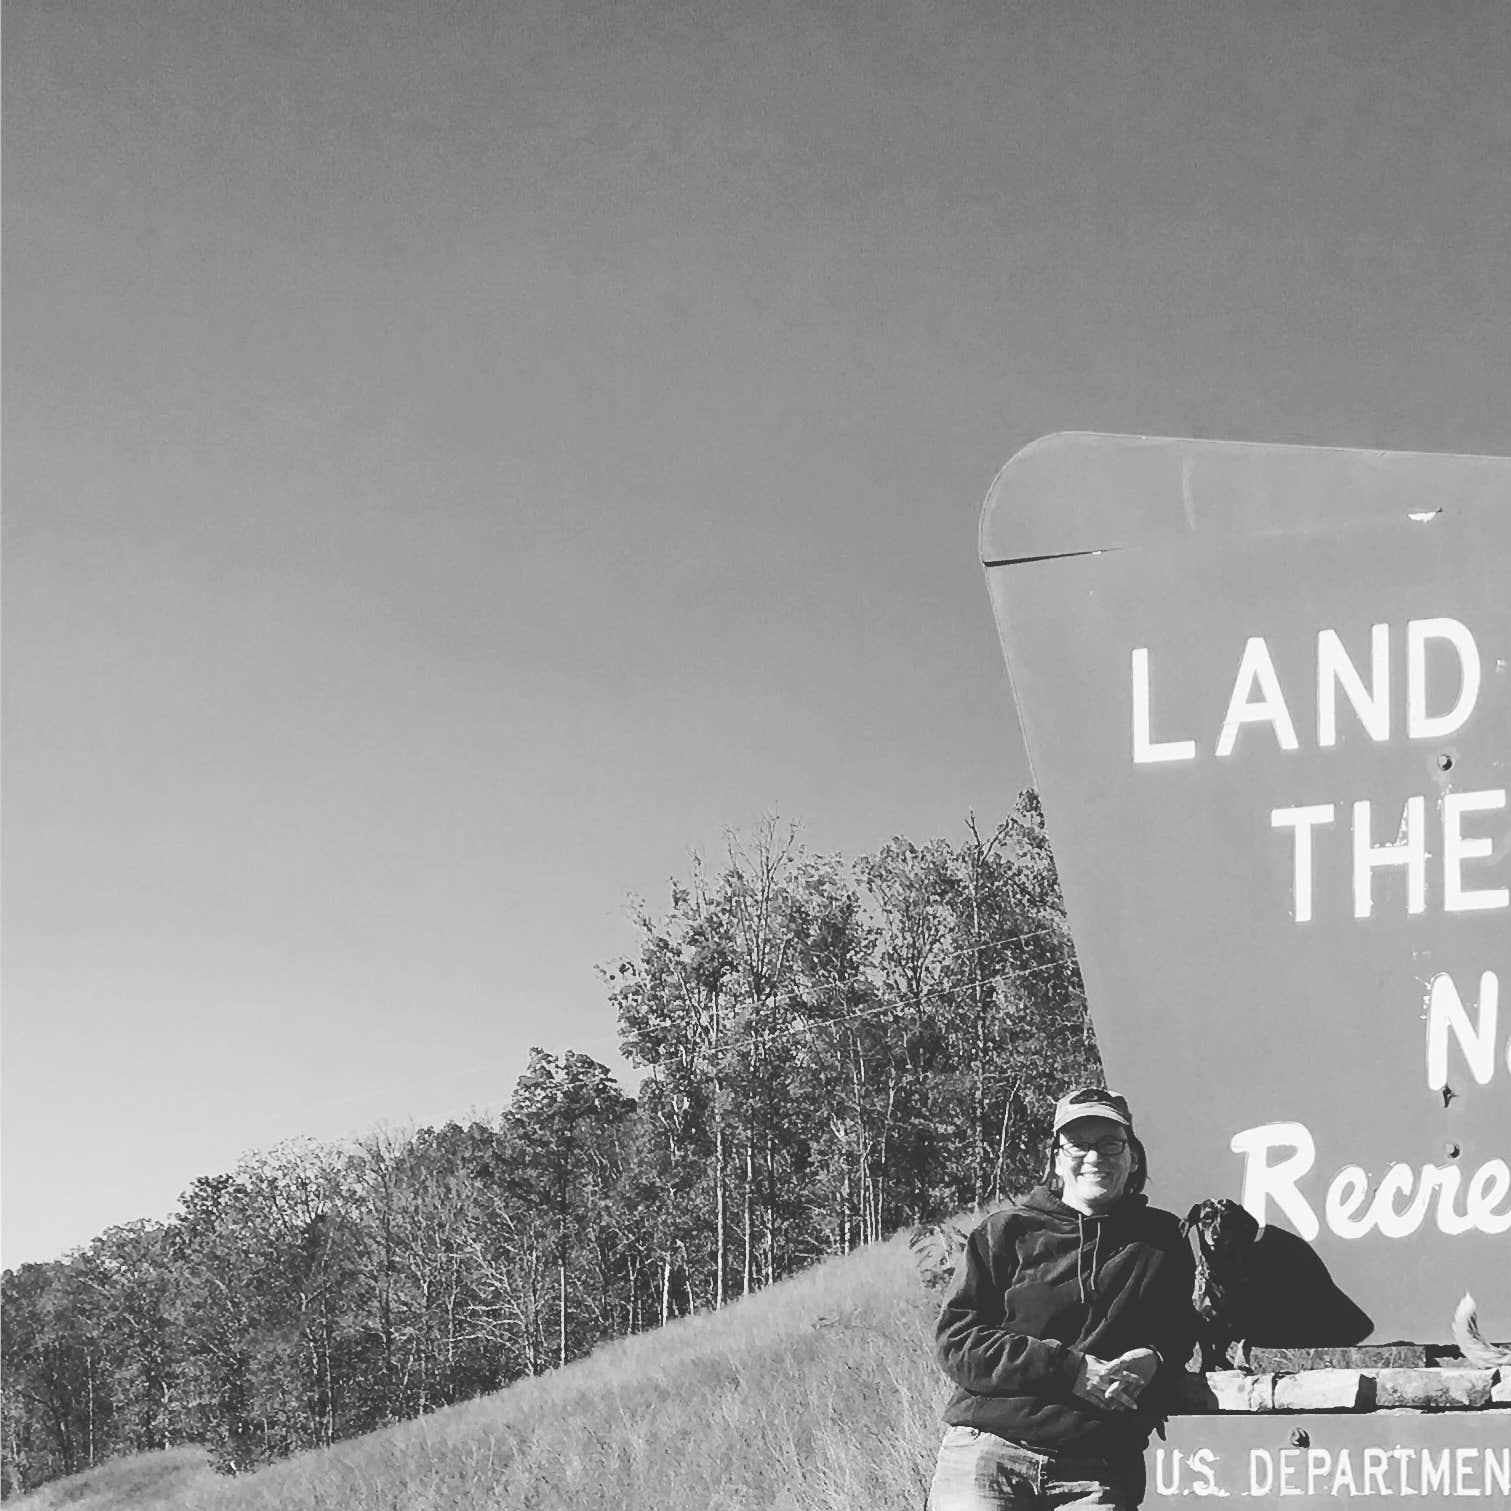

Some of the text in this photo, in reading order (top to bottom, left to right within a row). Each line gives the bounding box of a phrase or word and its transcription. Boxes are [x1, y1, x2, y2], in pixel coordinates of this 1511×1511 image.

[1131, 617, 1481, 763] LAND
[1270, 788, 1510, 922] THE
[1155, 1447, 1230, 1497] U.S.
